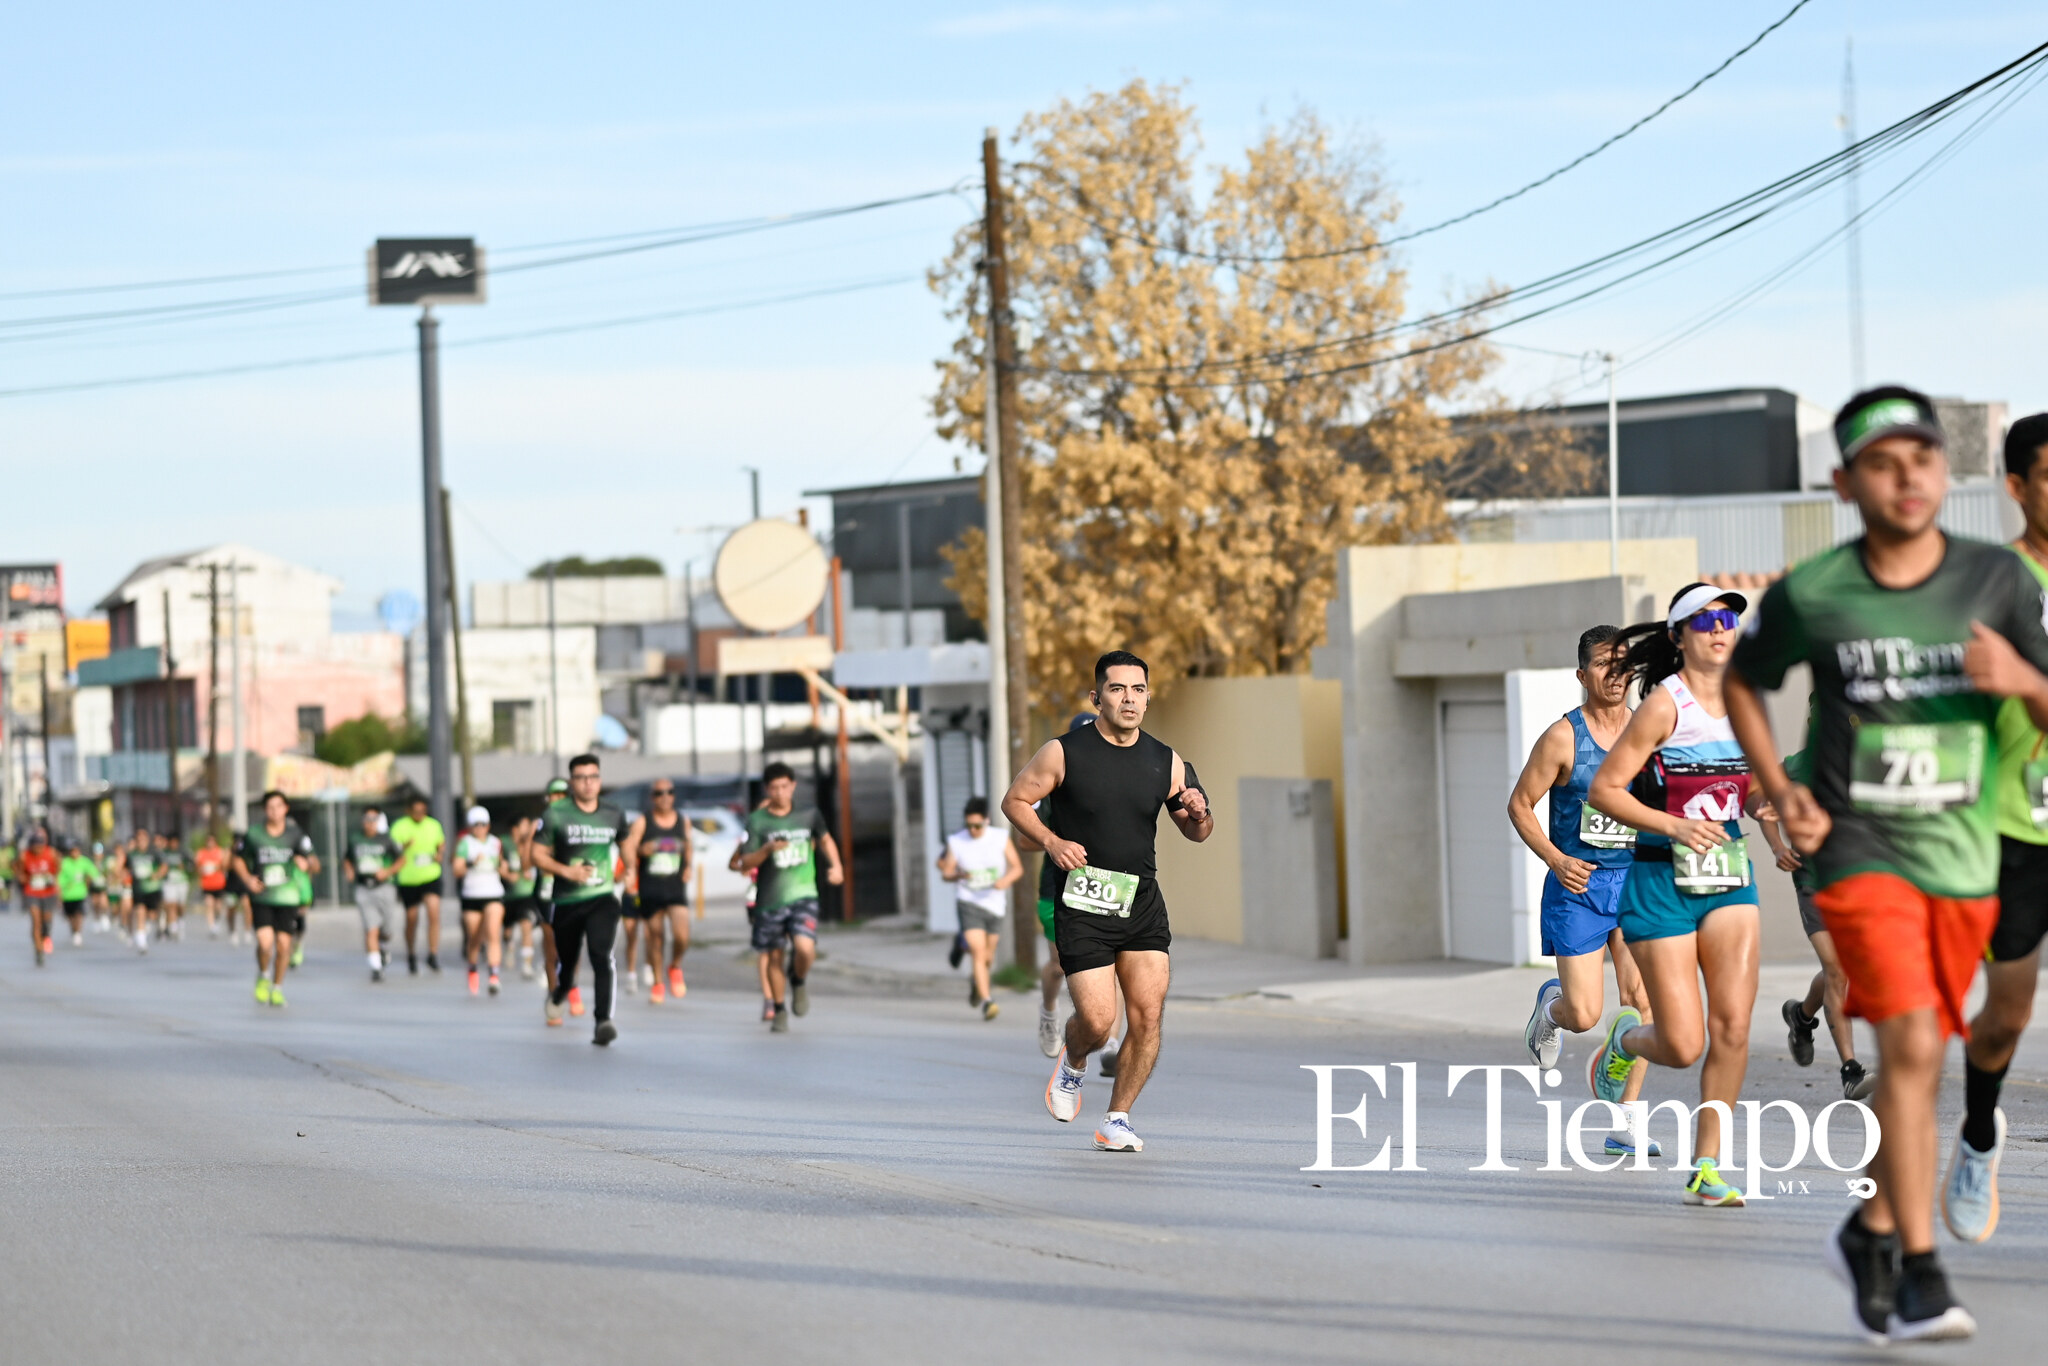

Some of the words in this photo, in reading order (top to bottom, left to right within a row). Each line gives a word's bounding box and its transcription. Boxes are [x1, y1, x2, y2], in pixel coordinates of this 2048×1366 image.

[1881, 750, 1940, 786] 70
[1685, 853, 1730, 877] 141
[1073, 876, 1117, 903] 330
